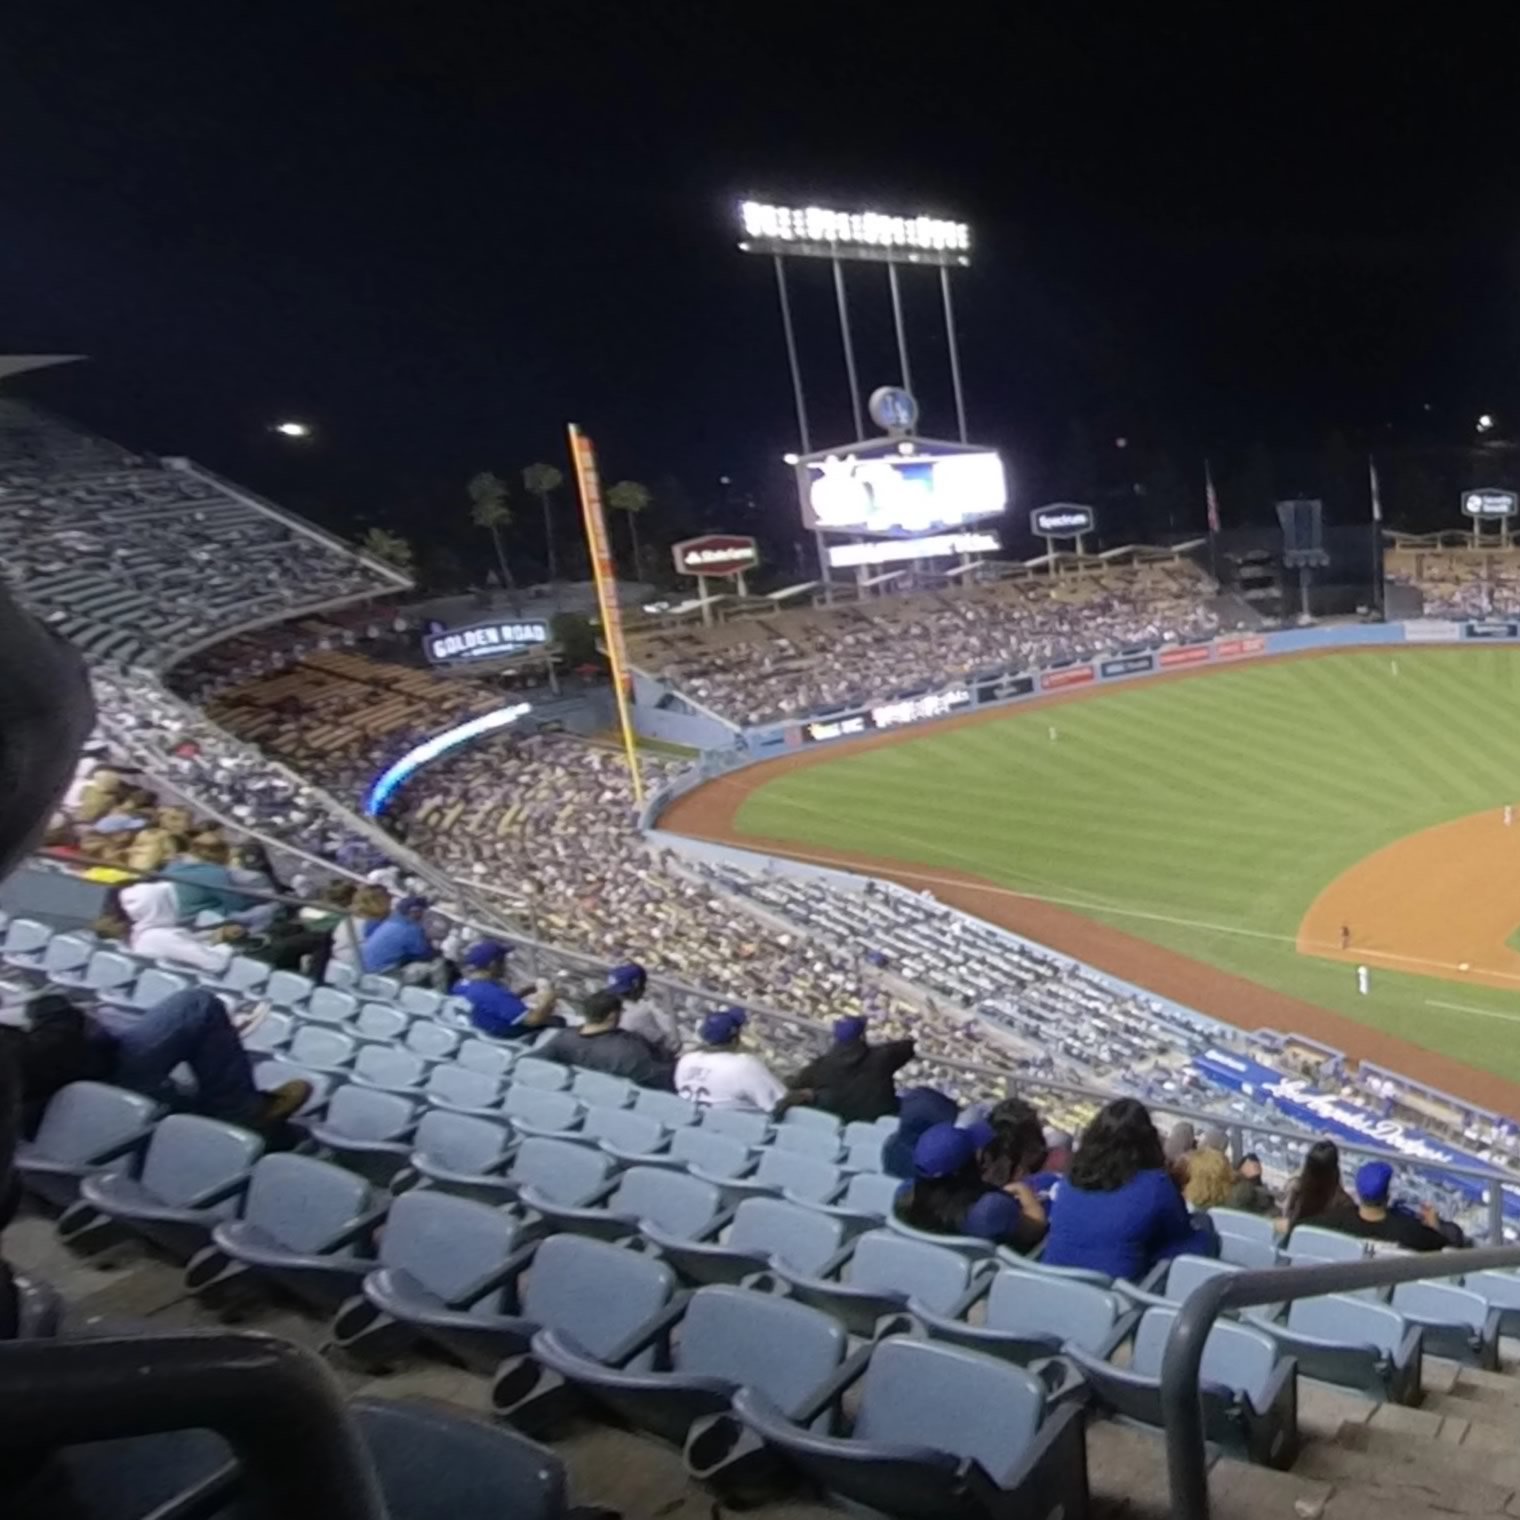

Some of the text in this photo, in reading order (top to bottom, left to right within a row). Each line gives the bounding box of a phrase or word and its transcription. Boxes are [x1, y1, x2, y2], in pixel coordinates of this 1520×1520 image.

[433, 627, 499, 658] GOLDEN
[501, 624, 545, 641] ROAD
[1362, 1119, 1453, 1163] Dodgers
